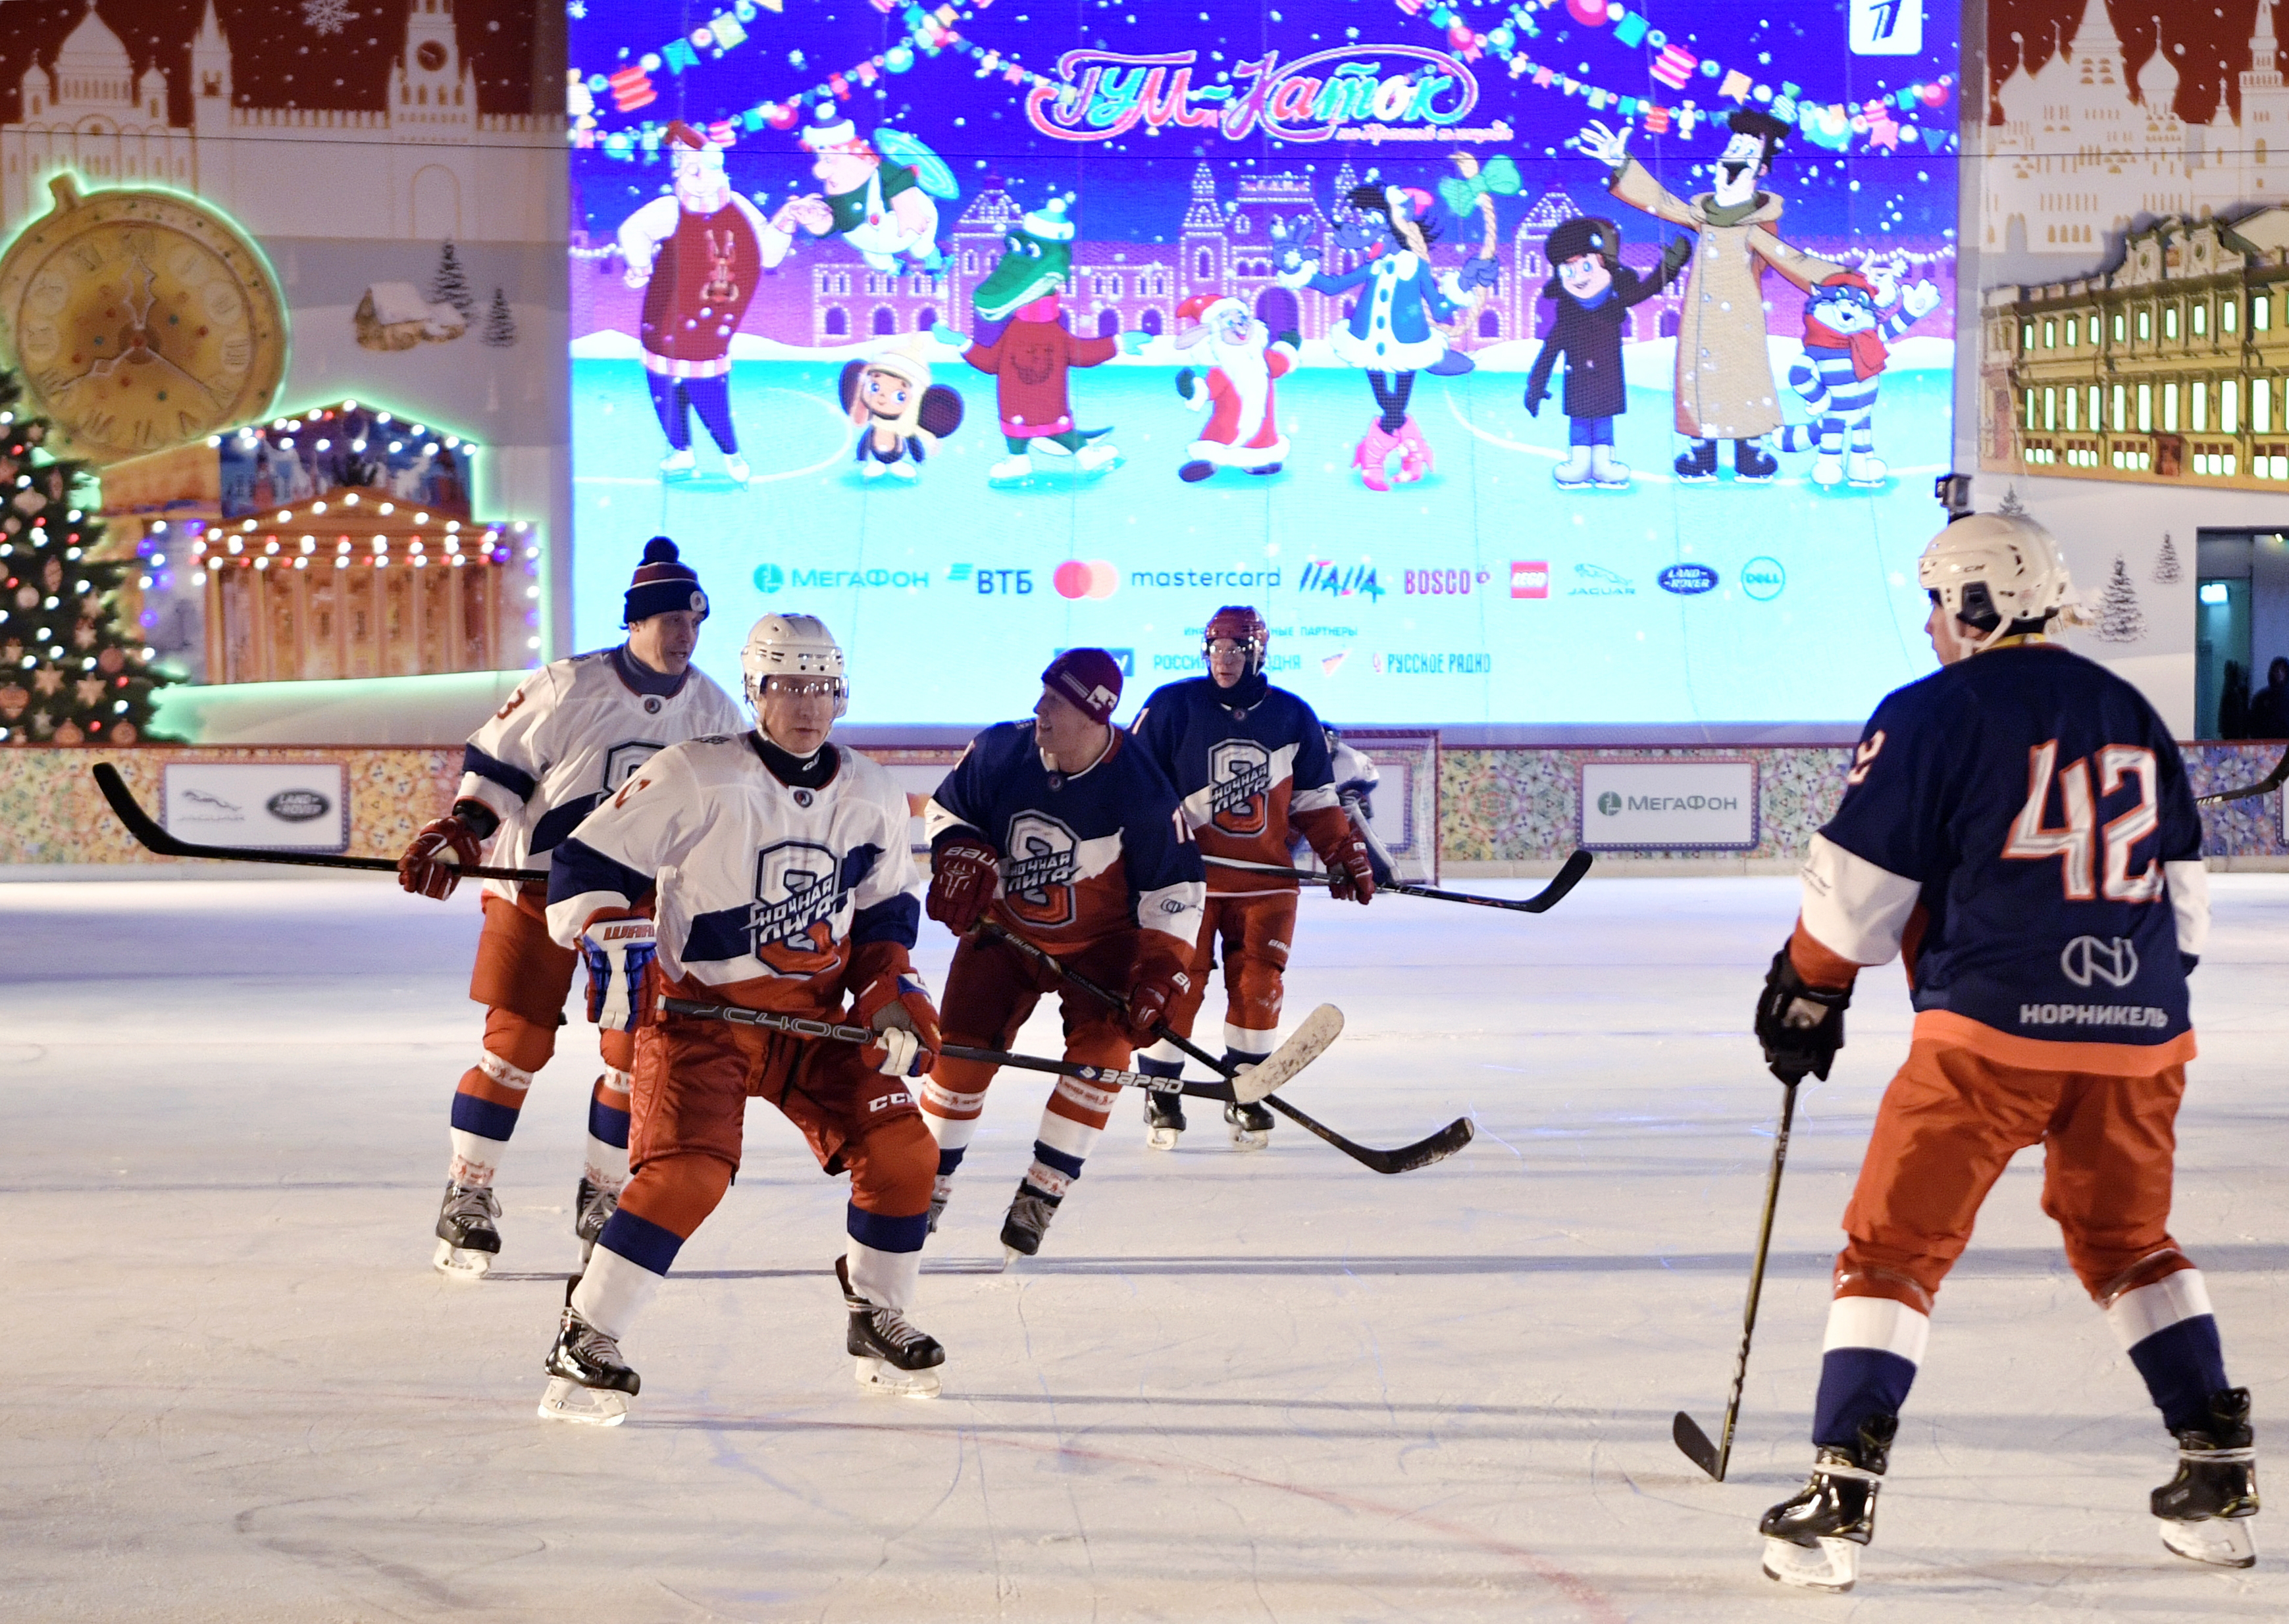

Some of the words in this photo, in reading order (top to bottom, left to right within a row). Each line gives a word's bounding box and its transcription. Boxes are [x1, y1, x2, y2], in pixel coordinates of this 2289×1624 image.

[977, 569, 1034, 595] ВТБ
[1131, 566, 1281, 588] mastercard
[1404, 568, 1472, 596] BOSCO
[1512, 571, 1548, 588] LEGO
[1746, 573, 1780, 584] DELL
[1300, 626, 1359, 636] ПАРТНЕРЫ
[1214, 763, 1267, 800] НОЧНАЯ
[1214, 776, 1268, 813] ЛИГА
[1999, 737, 2165, 903] 42
[1010, 853, 1071, 876] НОЧНАЯ
[1008, 866, 1069, 892] ЛИГА
[759, 876, 834, 926] НОЧНАЯ
[759, 894, 835, 944] ЛИГА
[2019, 1003, 2169, 1028] НОРНИКЕЛЬ
